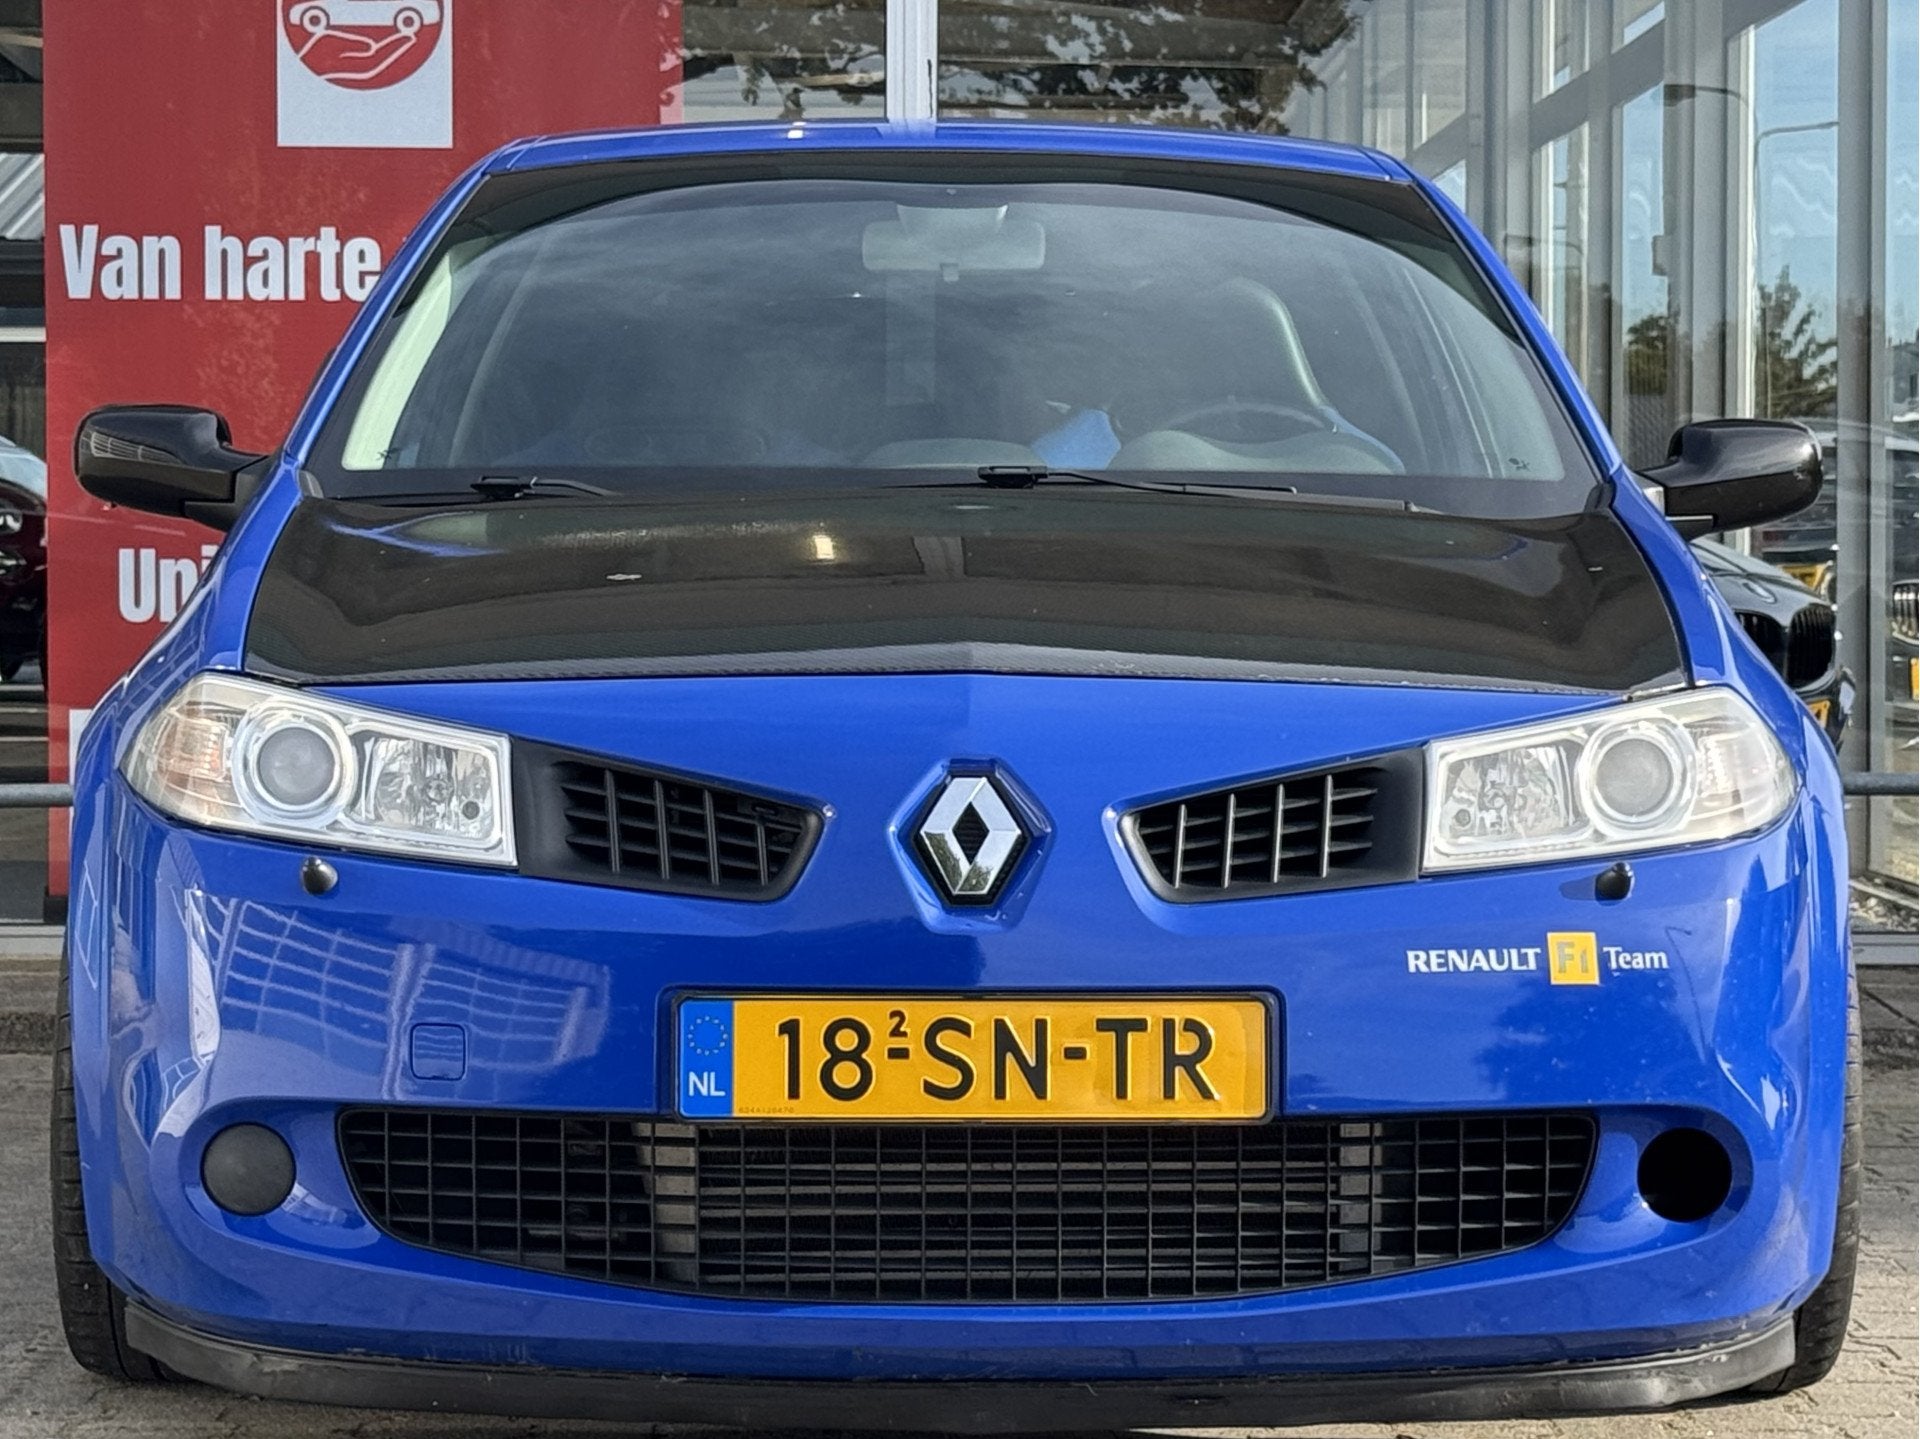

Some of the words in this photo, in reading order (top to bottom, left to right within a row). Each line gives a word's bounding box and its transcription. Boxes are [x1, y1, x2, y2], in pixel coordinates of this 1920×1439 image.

[59, 224, 181, 300] Van
[204, 225, 381, 301] harte
[119, 545, 219, 623] Un
[1406, 949, 1541, 973] RENAULT
[1556, 941, 1589, 973] F1
[1603, 946, 1669, 969] Team
[688, 1071, 726, 1096] NL
